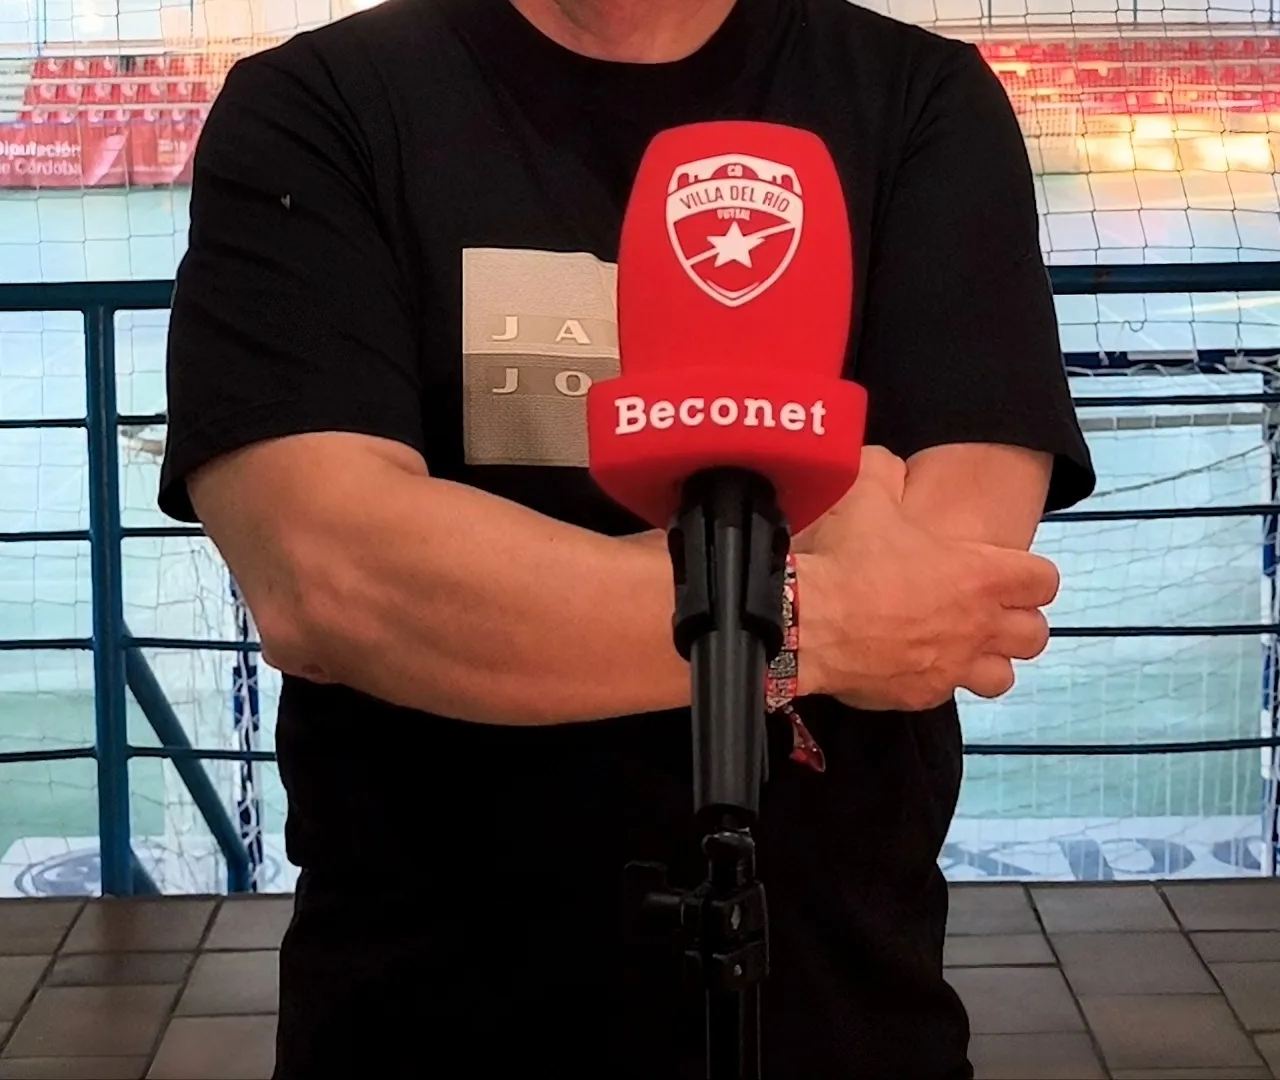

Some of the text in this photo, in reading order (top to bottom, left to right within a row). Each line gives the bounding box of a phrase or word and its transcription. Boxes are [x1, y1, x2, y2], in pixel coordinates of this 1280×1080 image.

[679, 185, 791, 213] VILLA DEL RÍO
[613, 395, 827, 437] Beconet
